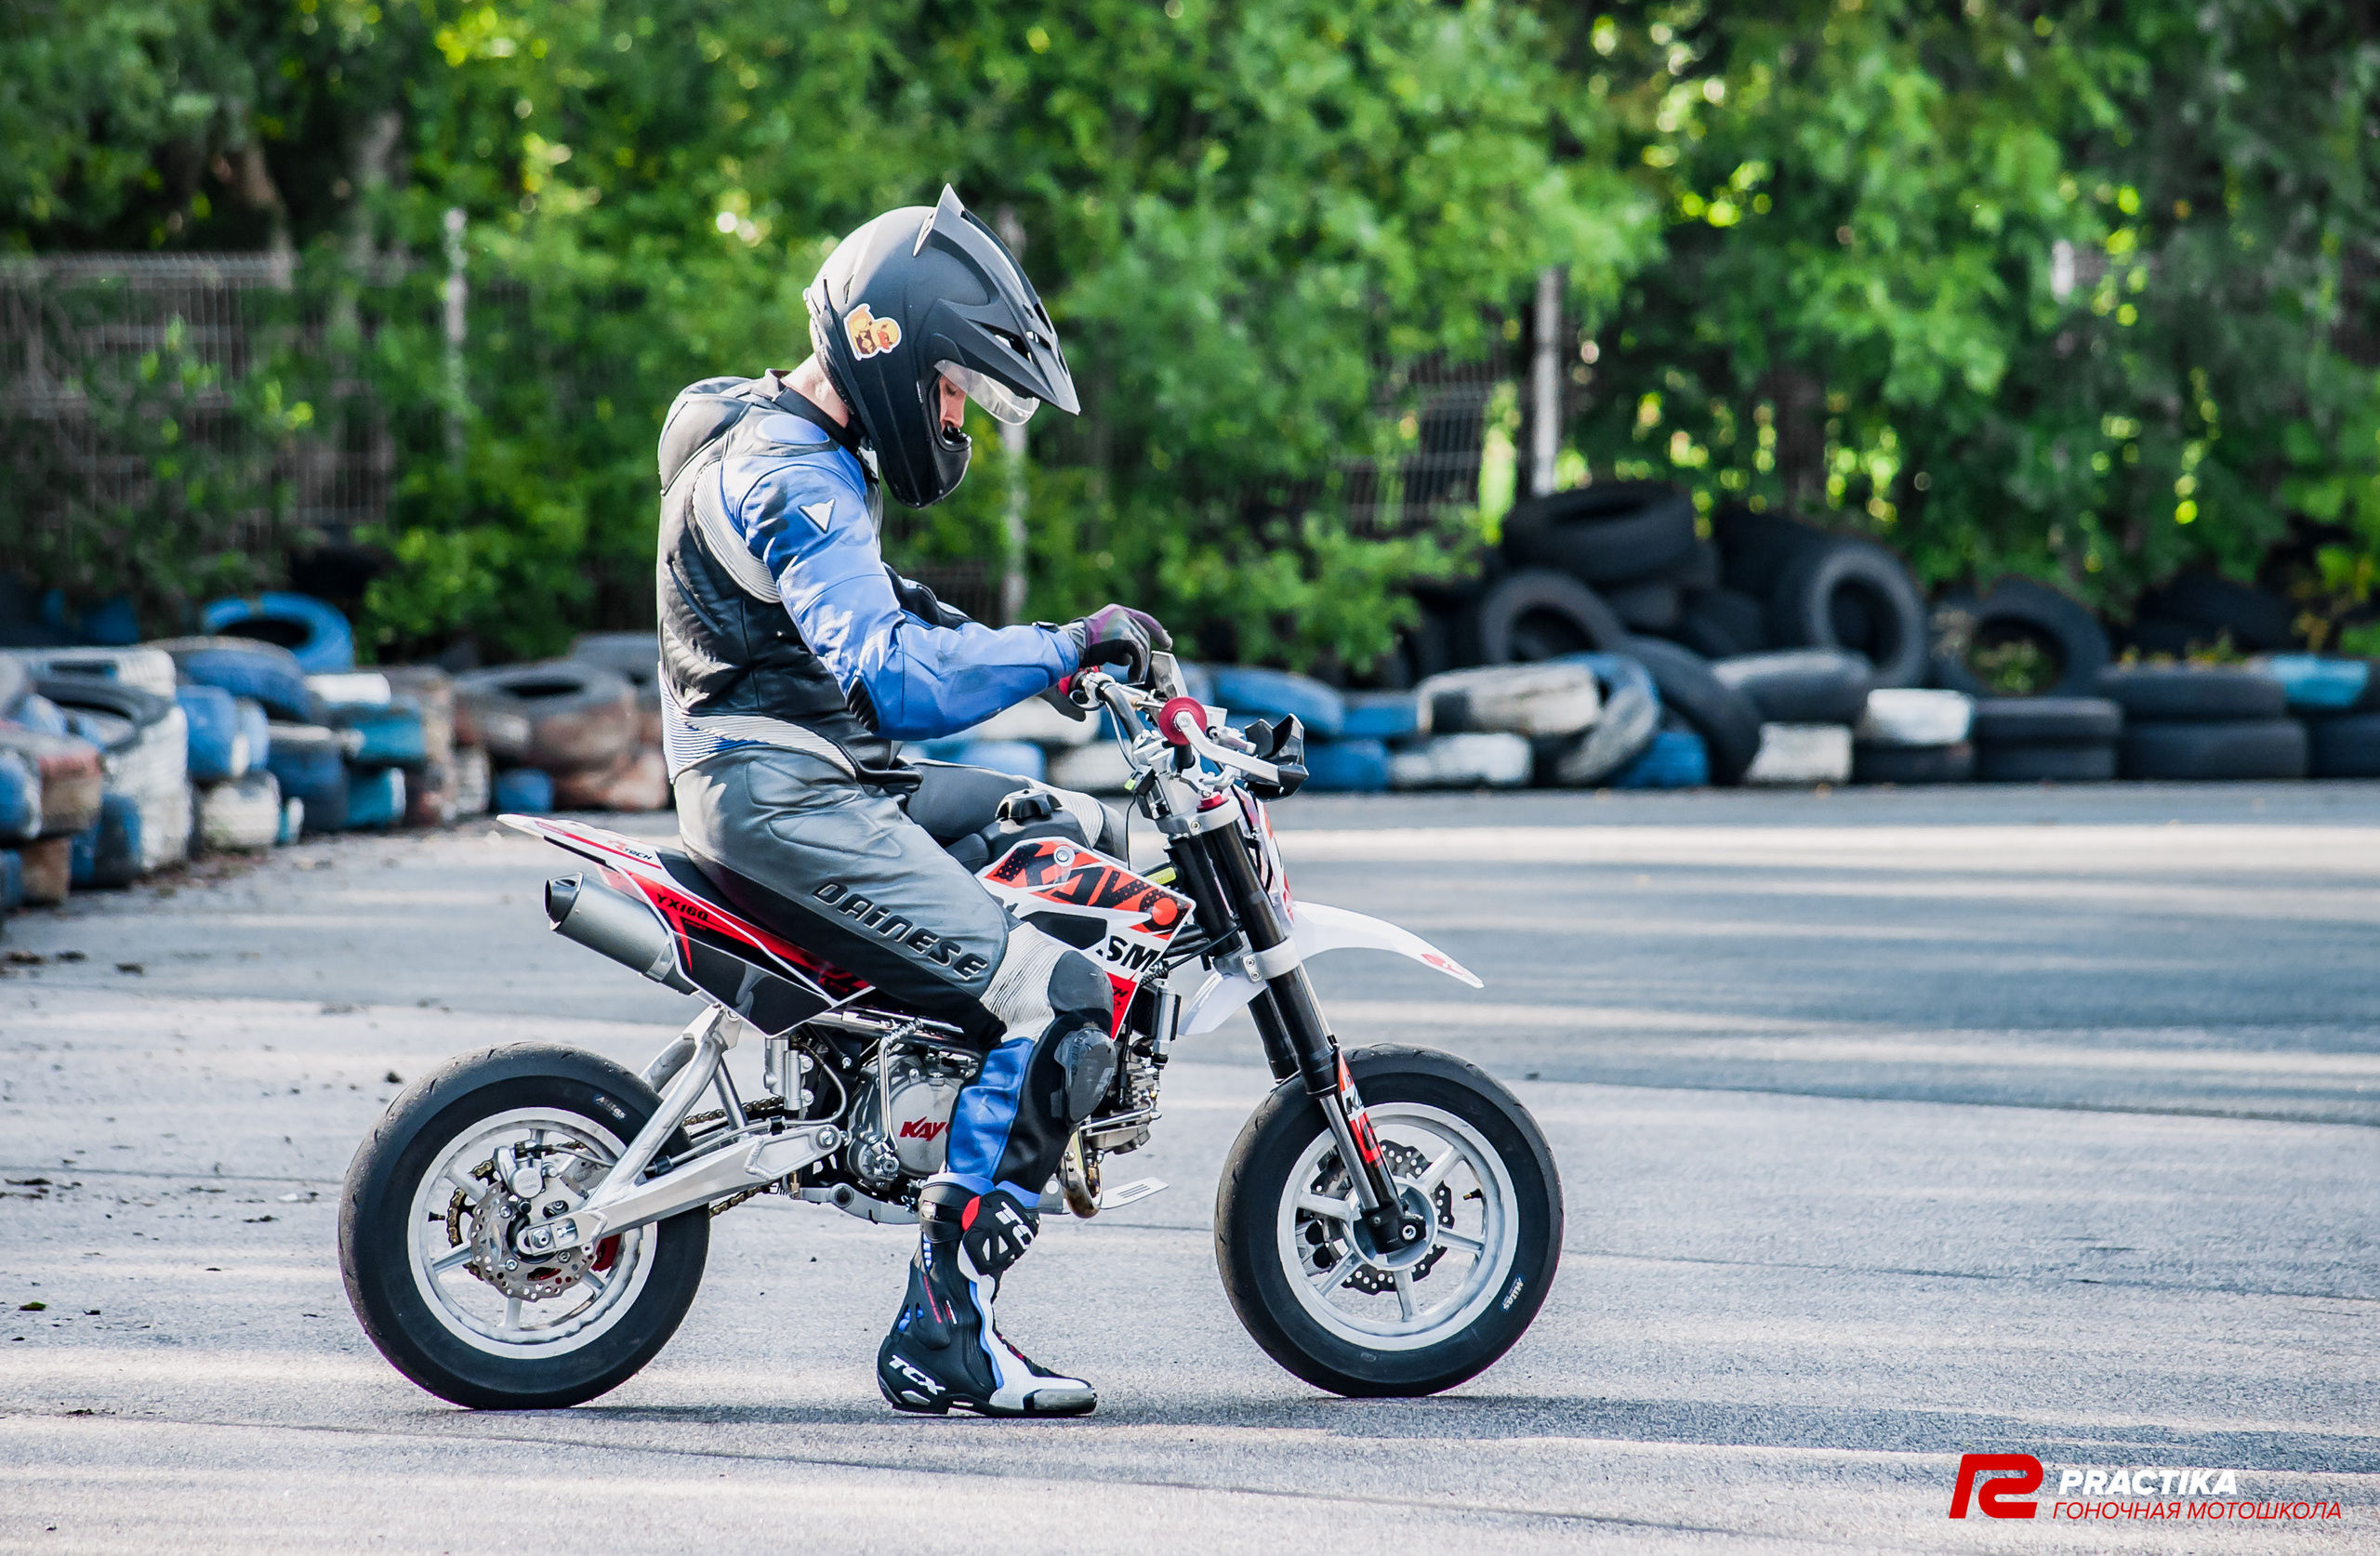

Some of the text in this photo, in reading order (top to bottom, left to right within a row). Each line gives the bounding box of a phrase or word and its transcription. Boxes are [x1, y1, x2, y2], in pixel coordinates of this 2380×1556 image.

[656, 892, 708, 921] YX160
[1096, 935, 1161, 973] SM
[995, 1201, 1035, 1250] TC
[889, 1353, 946, 1396] TCX
